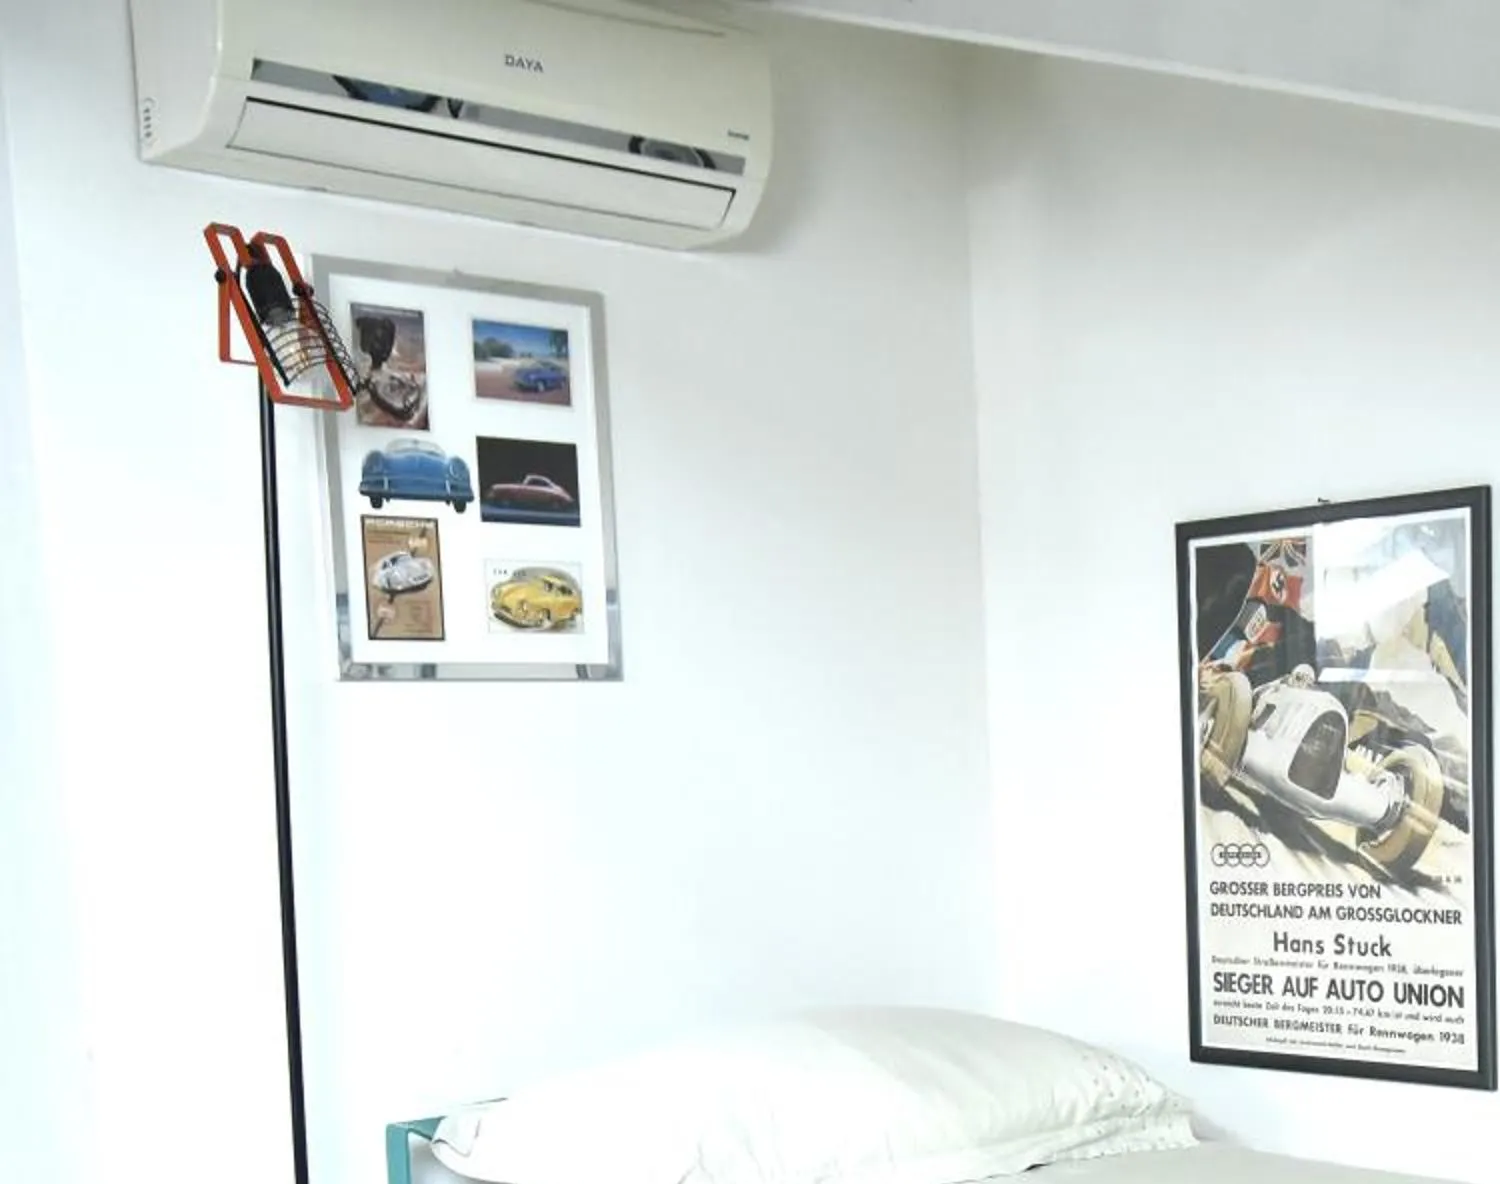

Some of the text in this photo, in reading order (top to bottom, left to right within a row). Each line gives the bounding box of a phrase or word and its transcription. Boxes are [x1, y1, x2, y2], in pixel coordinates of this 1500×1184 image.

[504, 54, 544, 73] DAYA
[1209, 881, 1382, 899] GROSSER BERGPREIS VON
[1210, 902, 1463, 925] DEUTSCHLAND AM GROSSGLOCKNER
[1273, 930, 1393, 957] Hans Stuck
[1213, 971, 1465, 1009] SIEGER AUF AUTO UNION
[1213, 1013, 1269, 1029] DEUTSCHER
[1273, 1018, 1343, 1035] BERGMEISTER
[1347, 1023, 1365, 1036] für
[1369, 1025, 1435, 1044] Rennwagen
